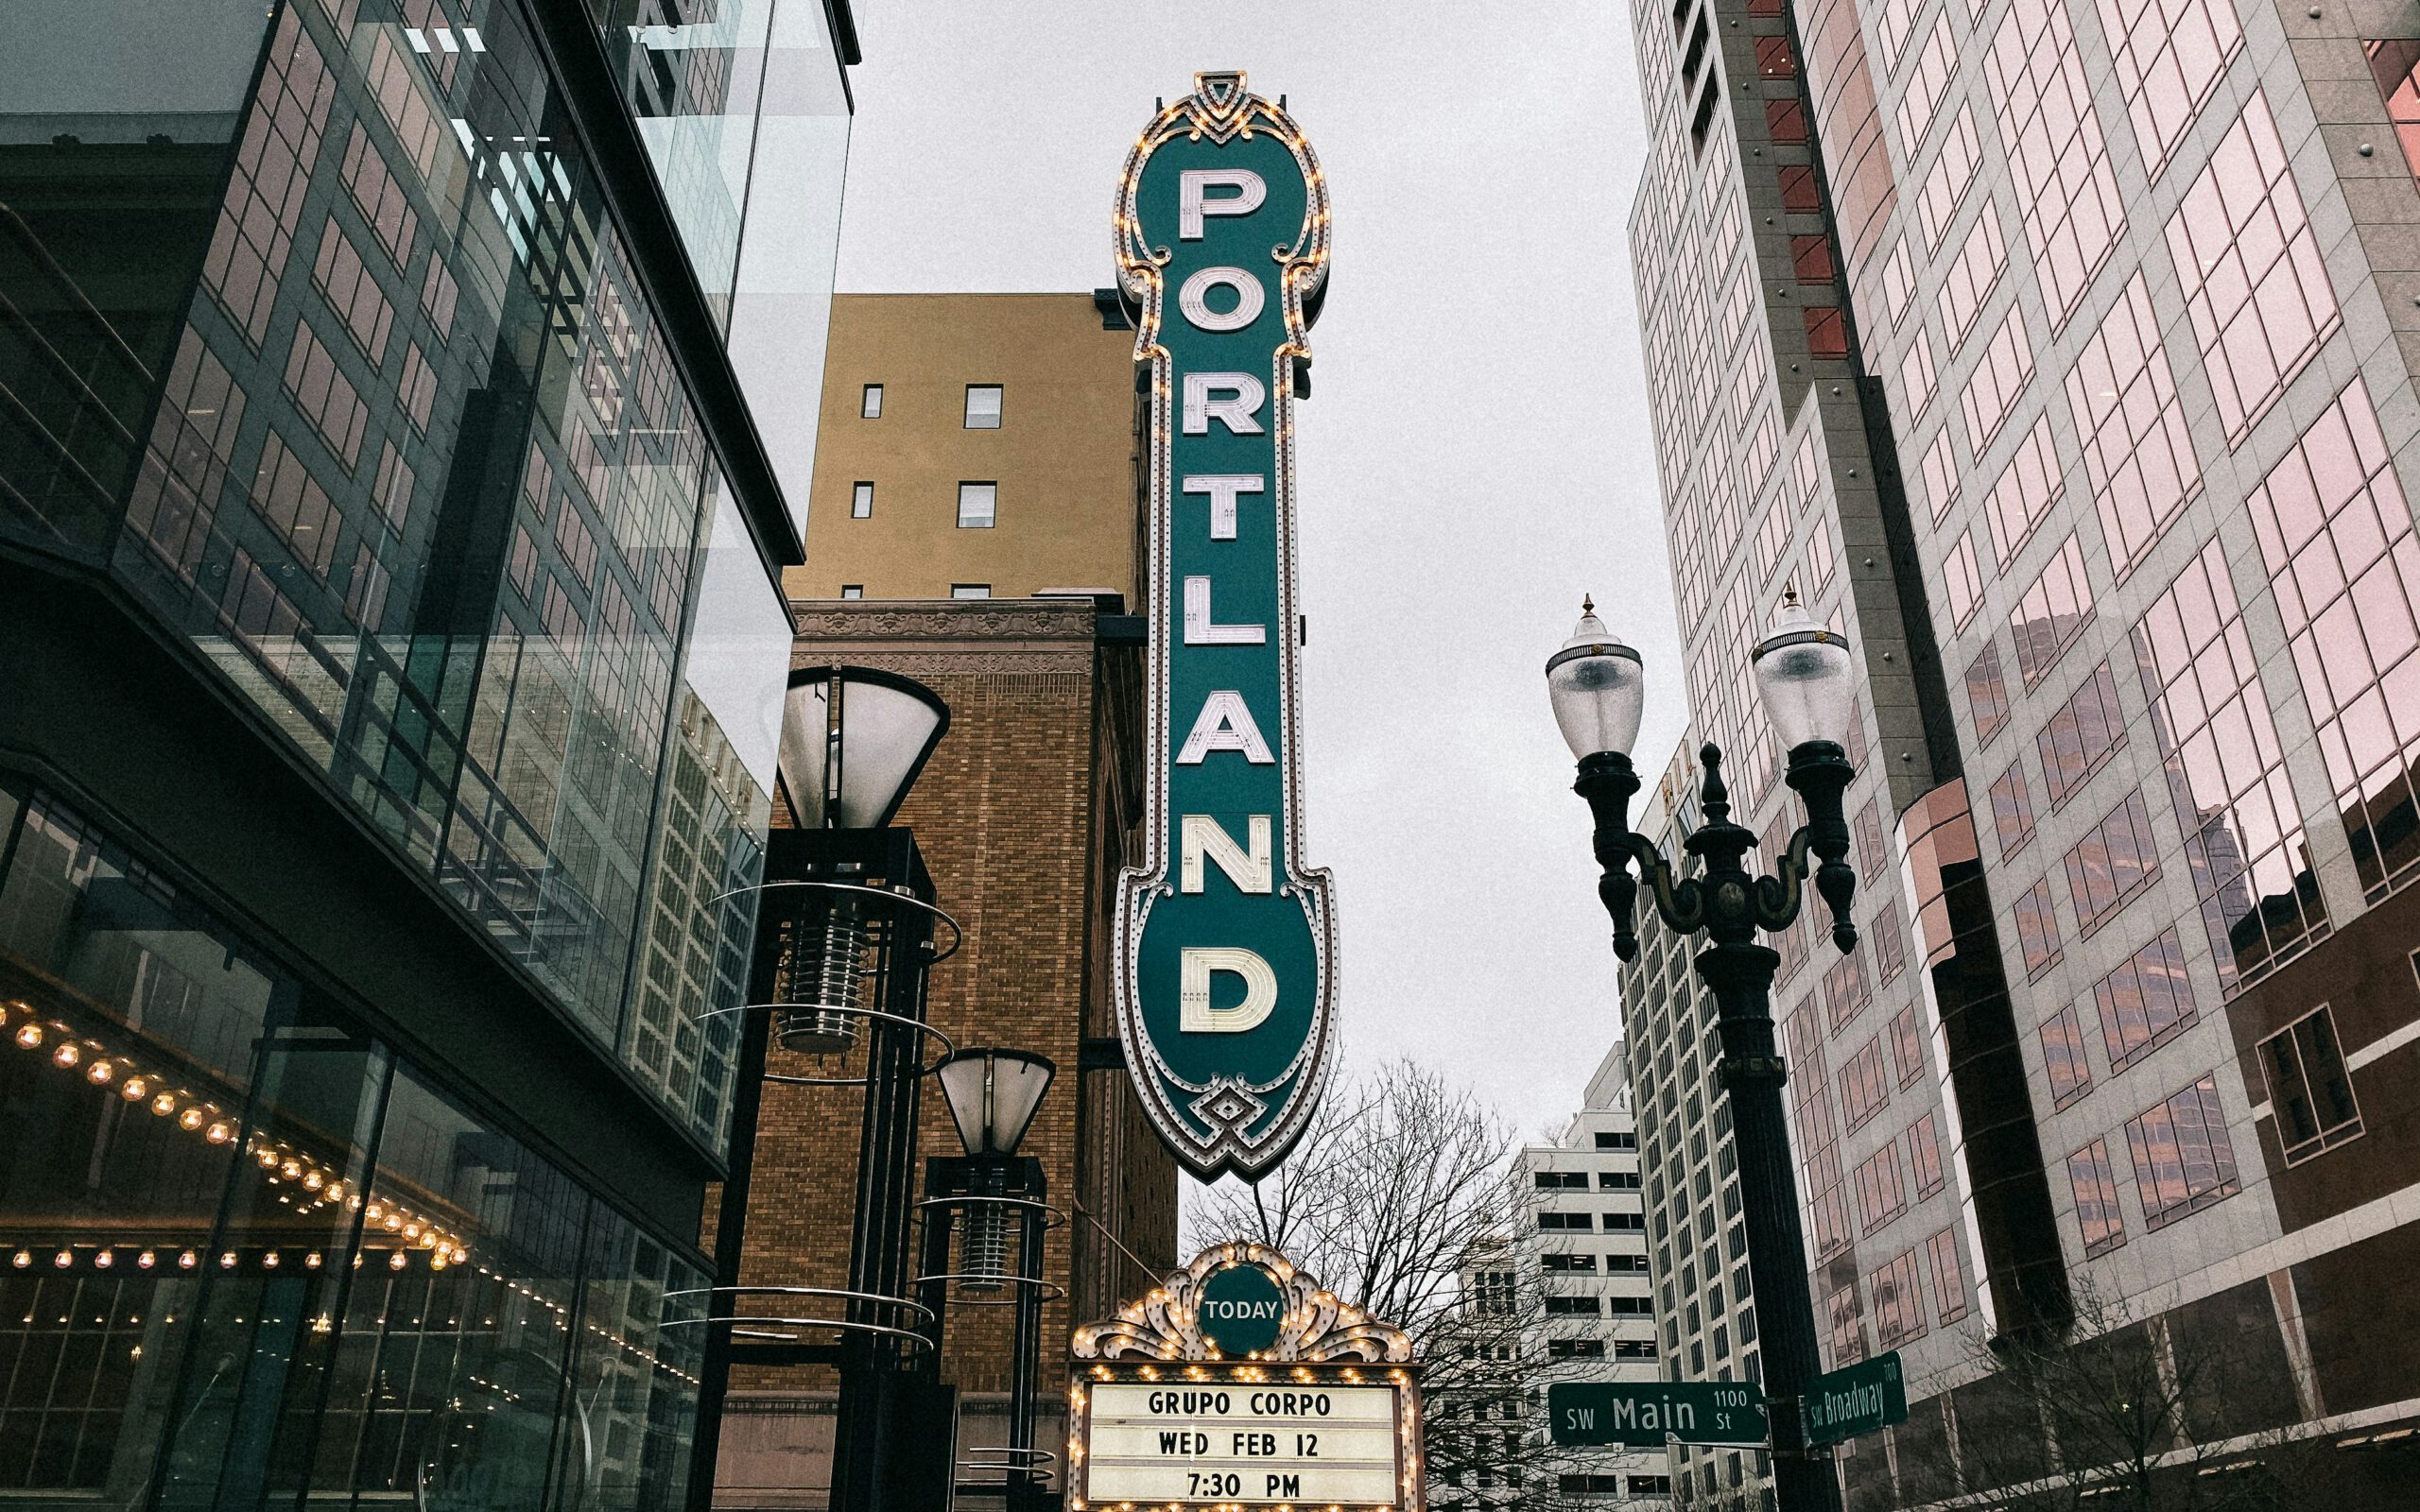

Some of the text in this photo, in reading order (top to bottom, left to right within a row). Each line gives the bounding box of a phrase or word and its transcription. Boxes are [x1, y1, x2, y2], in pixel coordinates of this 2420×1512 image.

[1176, 167, 1278, 1034] PORTLAND
[1204, 1300, 1277, 1318] TODAY
[1884, 1363, 1896, 1382] 700
[1149, 1391, 1331, 1417] GRUPO CORPO
[1714, 1390, 1747, 1407] 1100
[1812, 1382, 1883, 1428] SW Broadway
[1566, 1394, 1732, 1430] SW Main St
[1159, 1432, 1318, 1456] WED FEB 12
[1188, 1472, 1300, 1498] 7:30 PM
